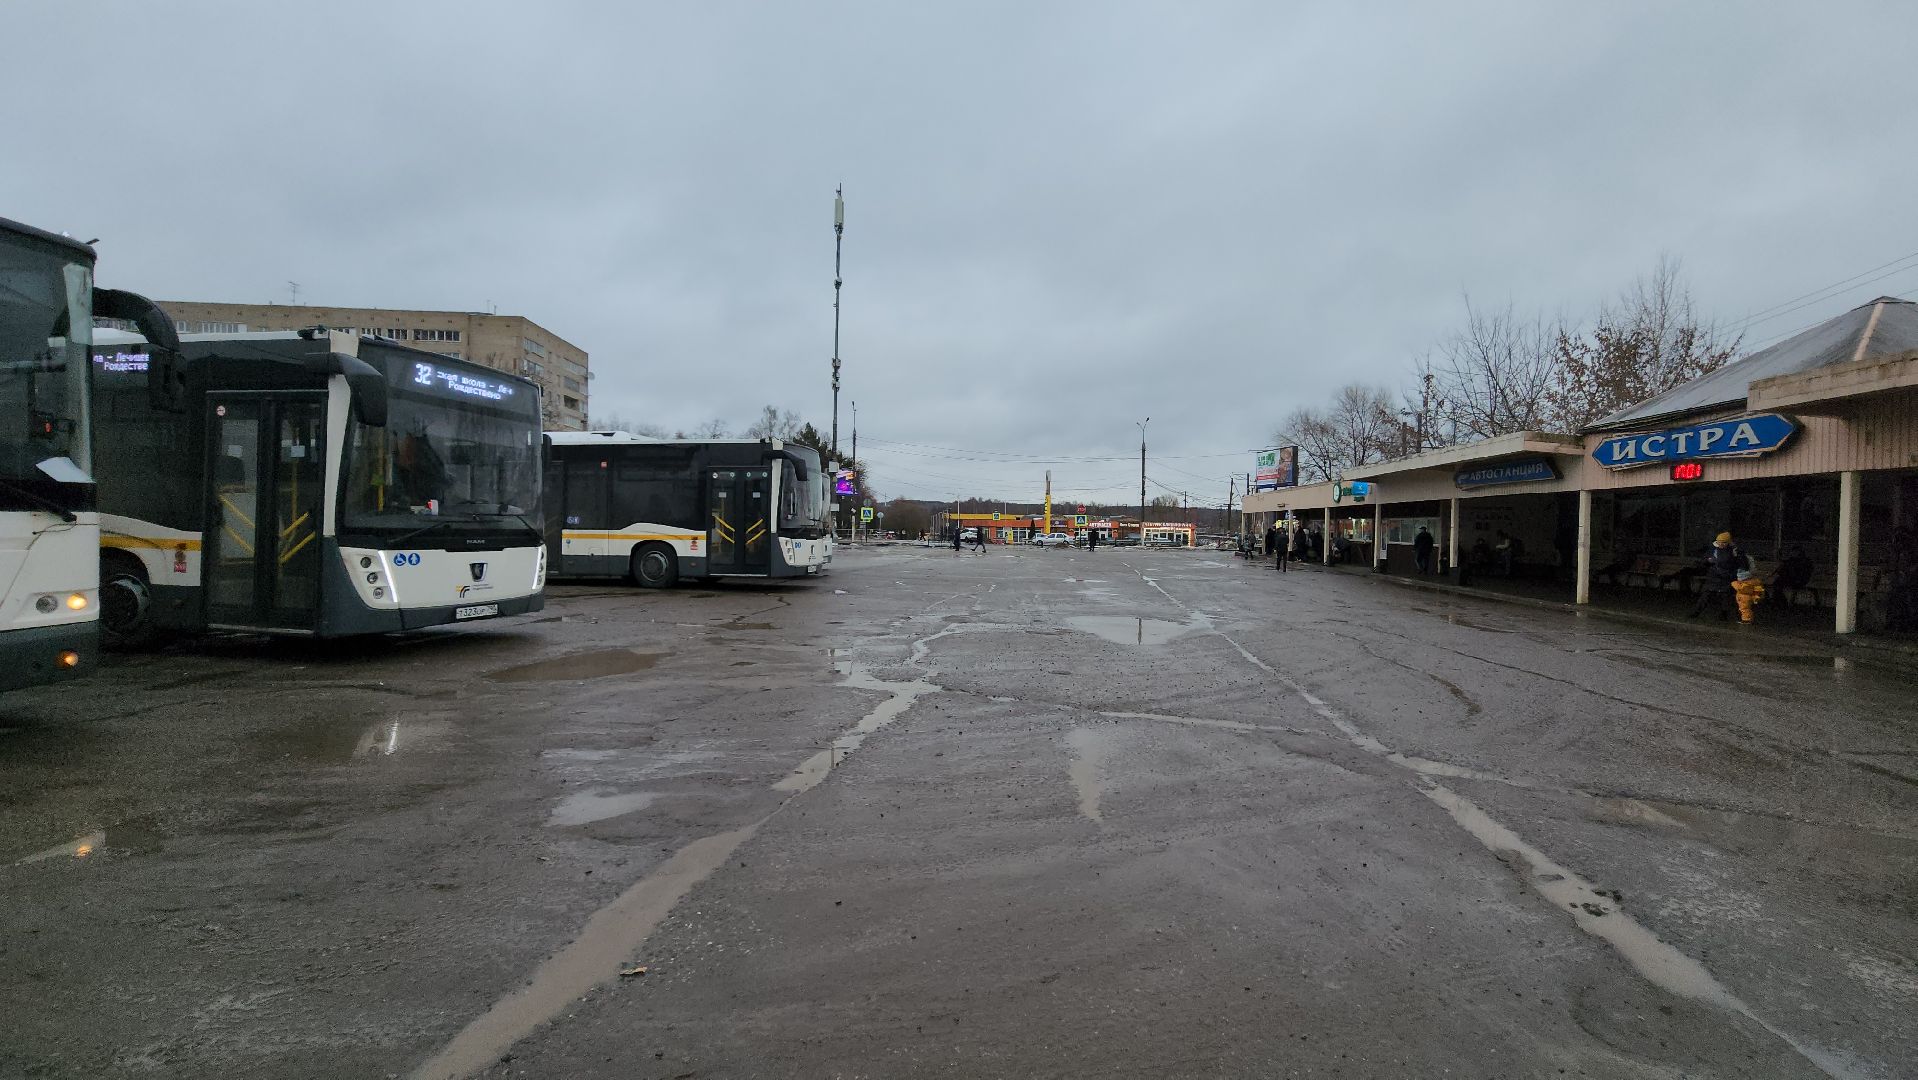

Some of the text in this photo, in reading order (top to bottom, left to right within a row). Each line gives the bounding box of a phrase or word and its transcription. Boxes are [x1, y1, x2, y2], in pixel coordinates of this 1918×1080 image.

[414, 363, 432, 386] 32
[1612, 422, 1761, 461] ИСТРА
[1470, 462, 1544, 481] АВТОСТАНЦИЯ
